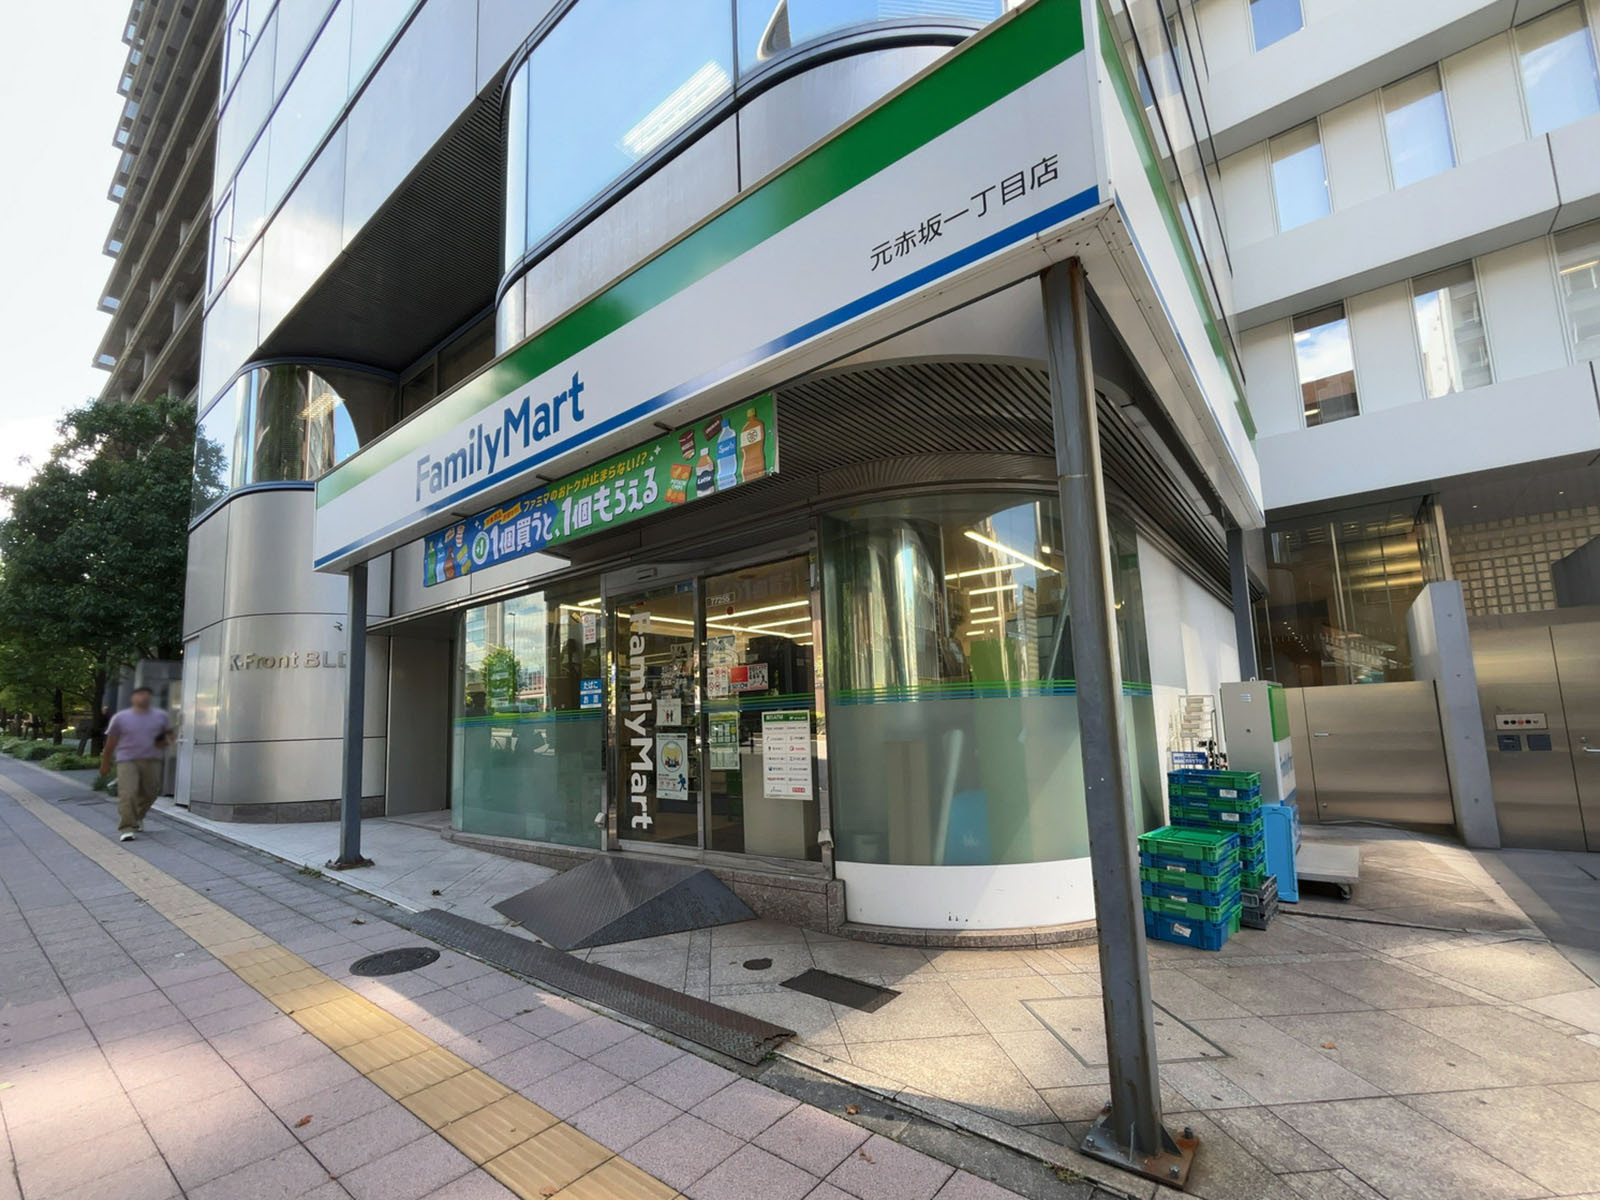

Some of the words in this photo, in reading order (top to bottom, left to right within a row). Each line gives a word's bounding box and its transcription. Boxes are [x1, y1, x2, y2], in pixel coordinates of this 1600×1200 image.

[870, 154, 1058, 271] 元赤坂一丁目店
[415, 371, 585, 502] FamilyMart
[624, 612, 653, 829] FamilyMart
